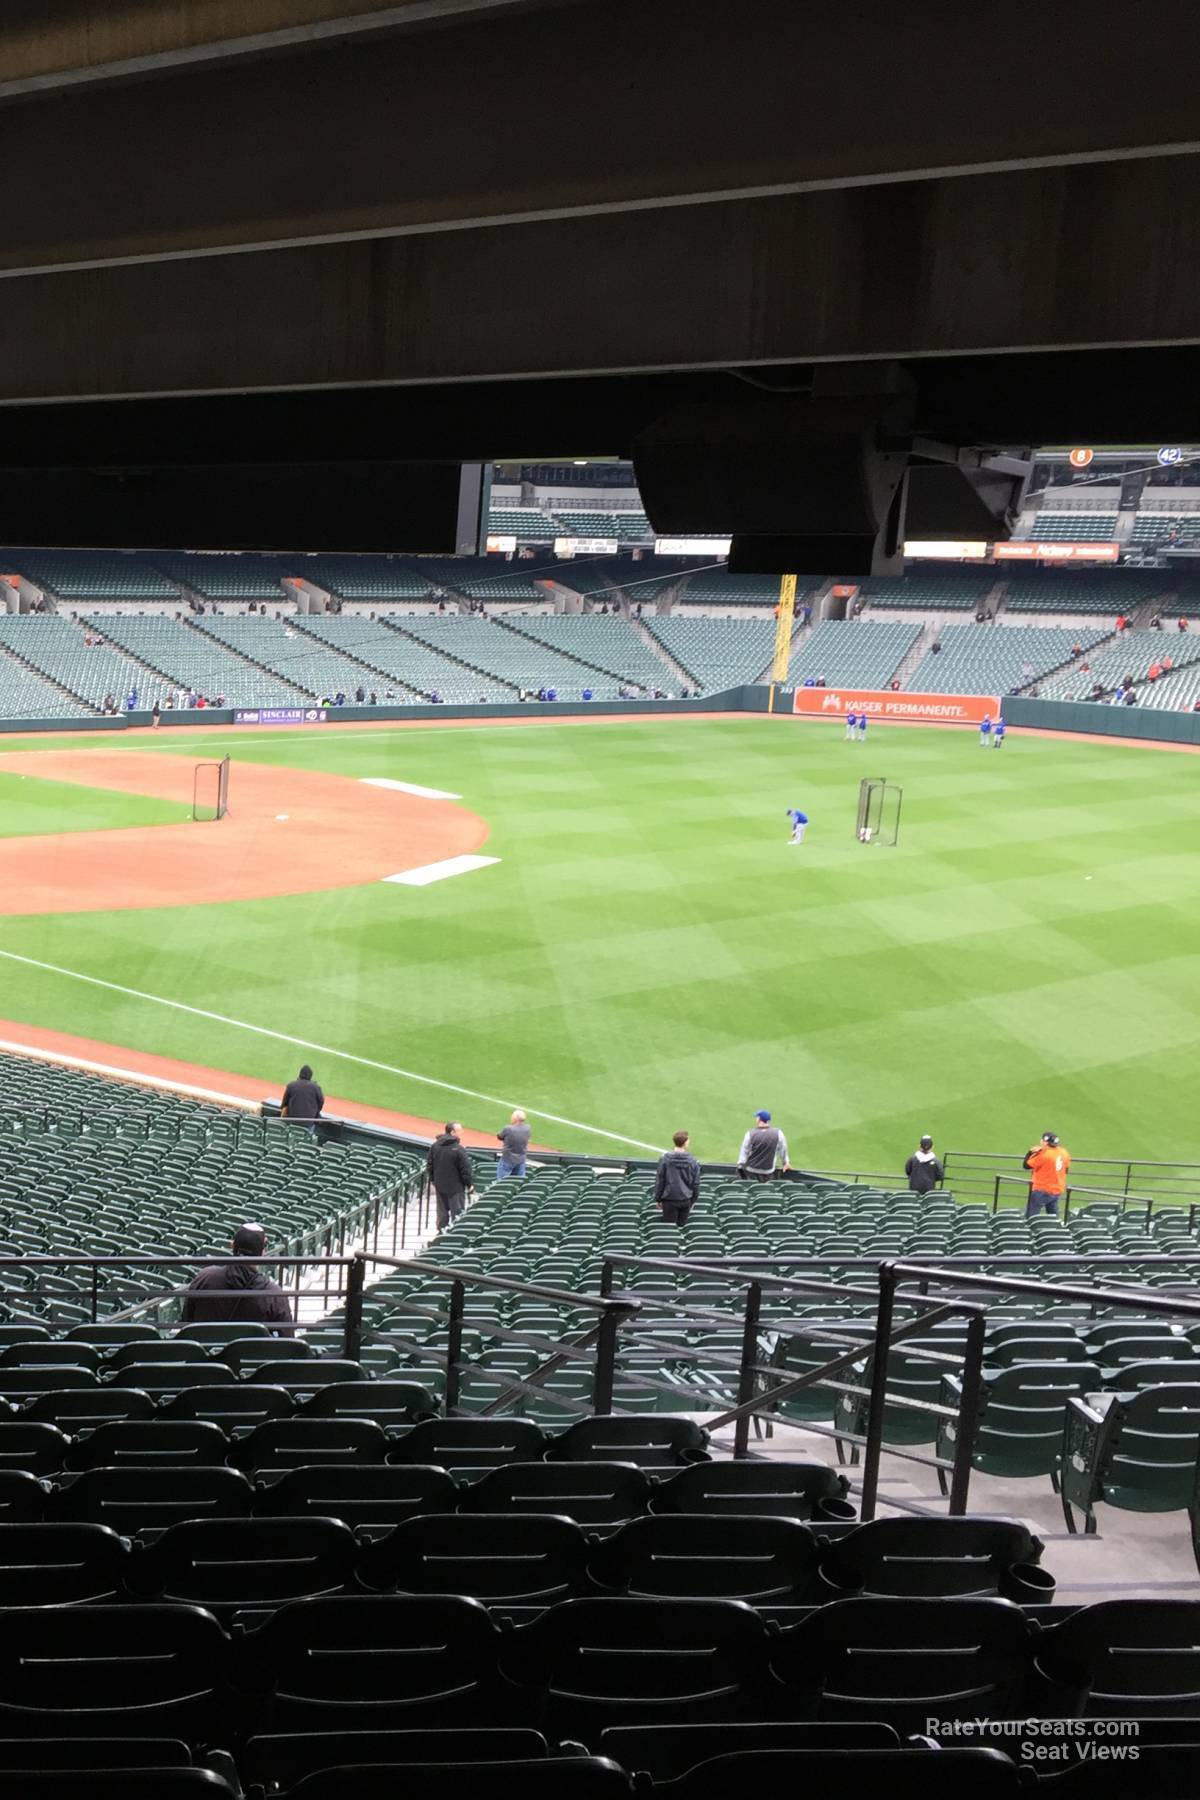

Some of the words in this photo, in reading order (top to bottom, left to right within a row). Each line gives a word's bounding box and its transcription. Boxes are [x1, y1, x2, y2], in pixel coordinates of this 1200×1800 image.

[1160, 449, 1177, 460] 42
[845, 701, 882, 712] KAISER
[886, 703, 964, 716] PERMANENTE
